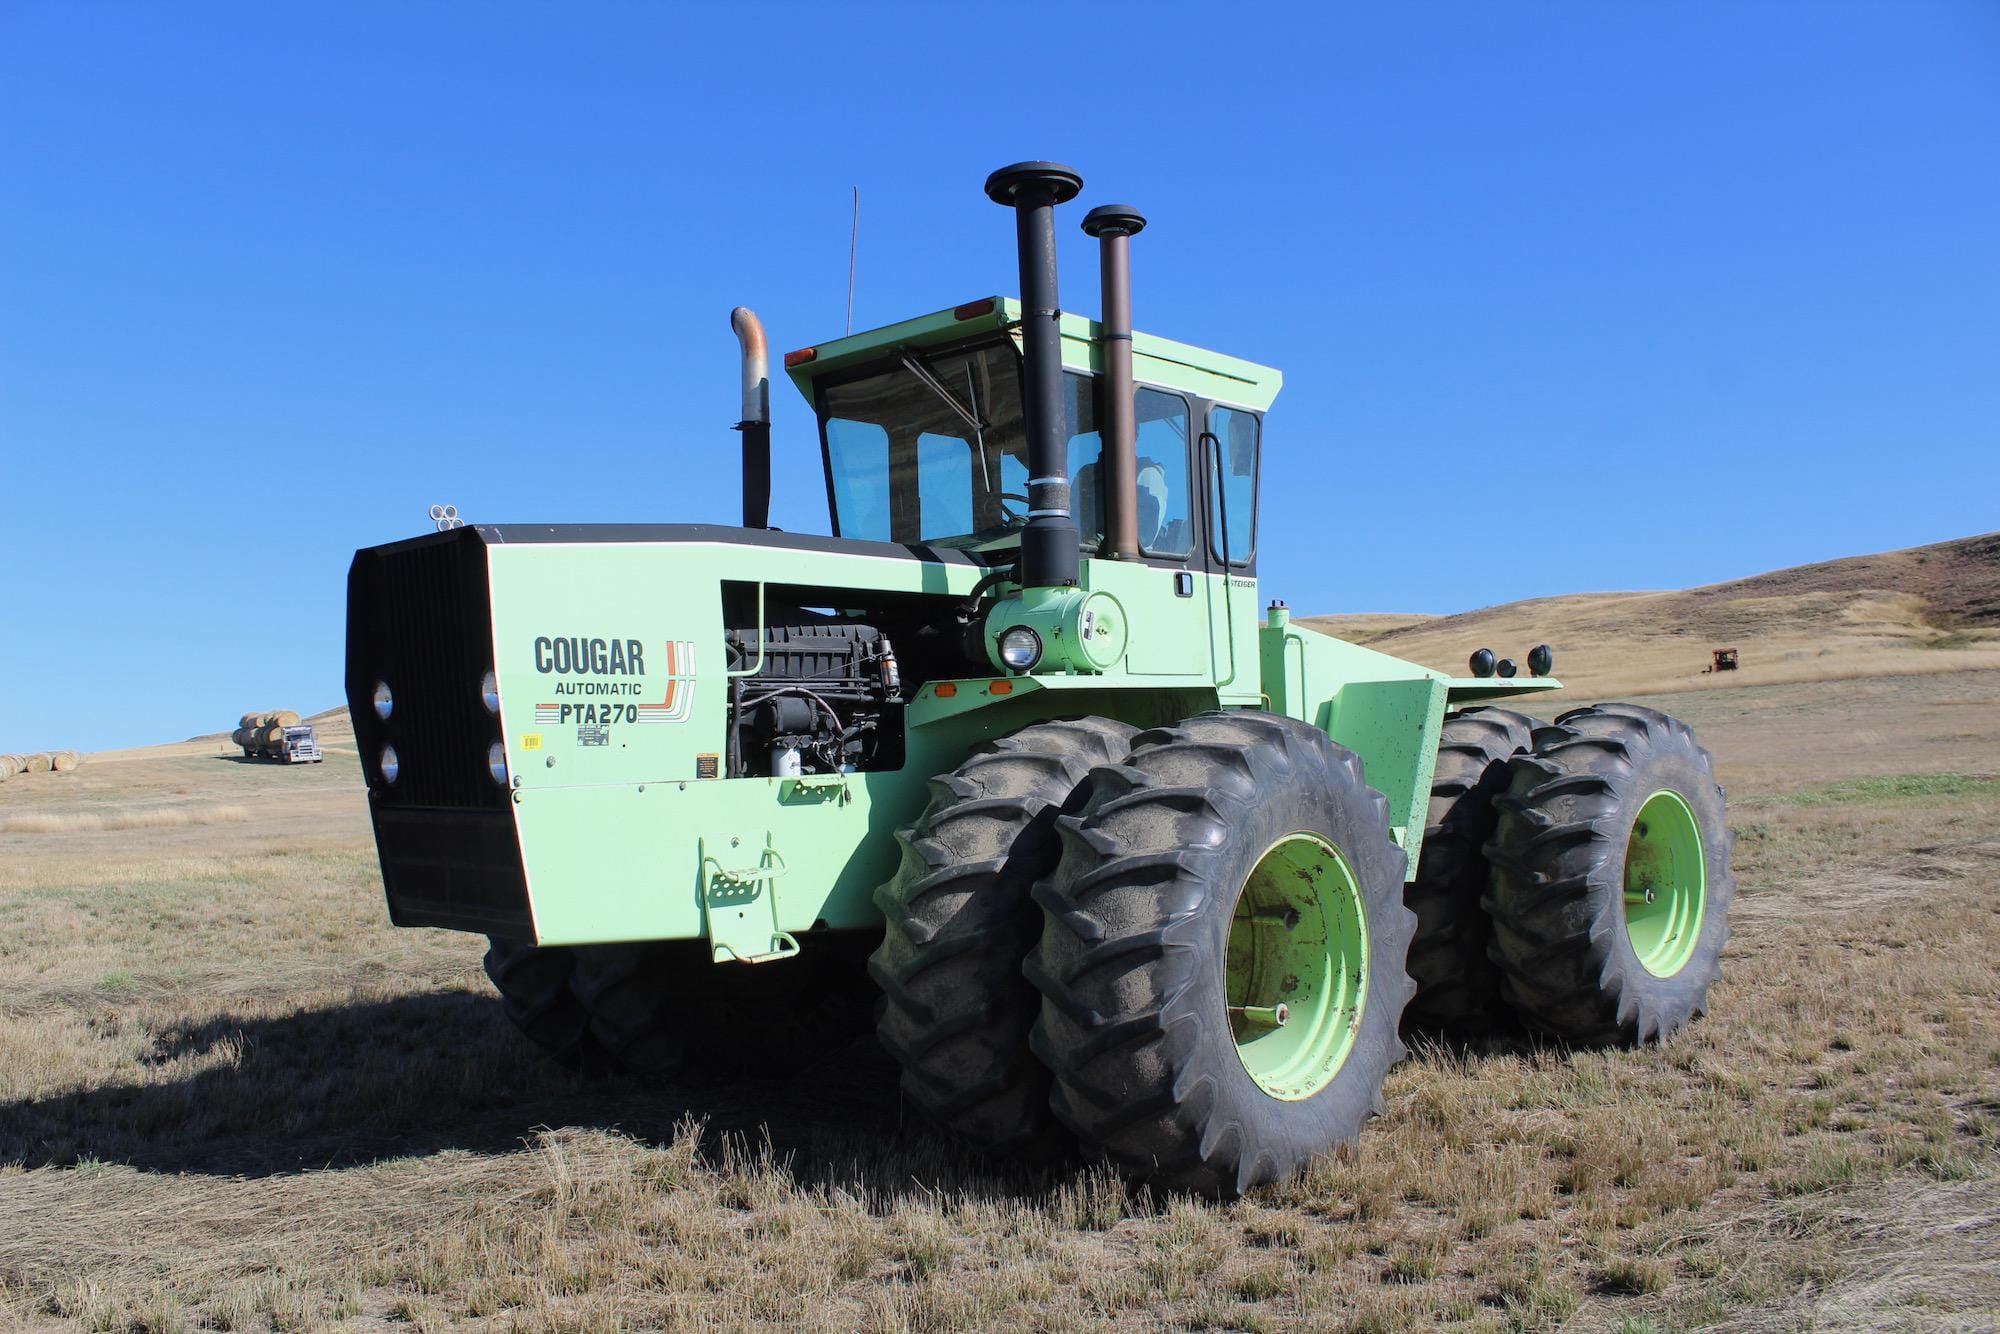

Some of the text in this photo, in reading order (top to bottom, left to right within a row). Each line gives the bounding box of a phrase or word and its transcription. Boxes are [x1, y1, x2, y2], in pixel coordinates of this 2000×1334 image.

[1230, 580, 1256, 588] STEIGER
[535, 637, 645, 675] COUGAR
[555, 682, 642, 695] AUTOMATIC
[559, 703, 638, 724] PTA270
